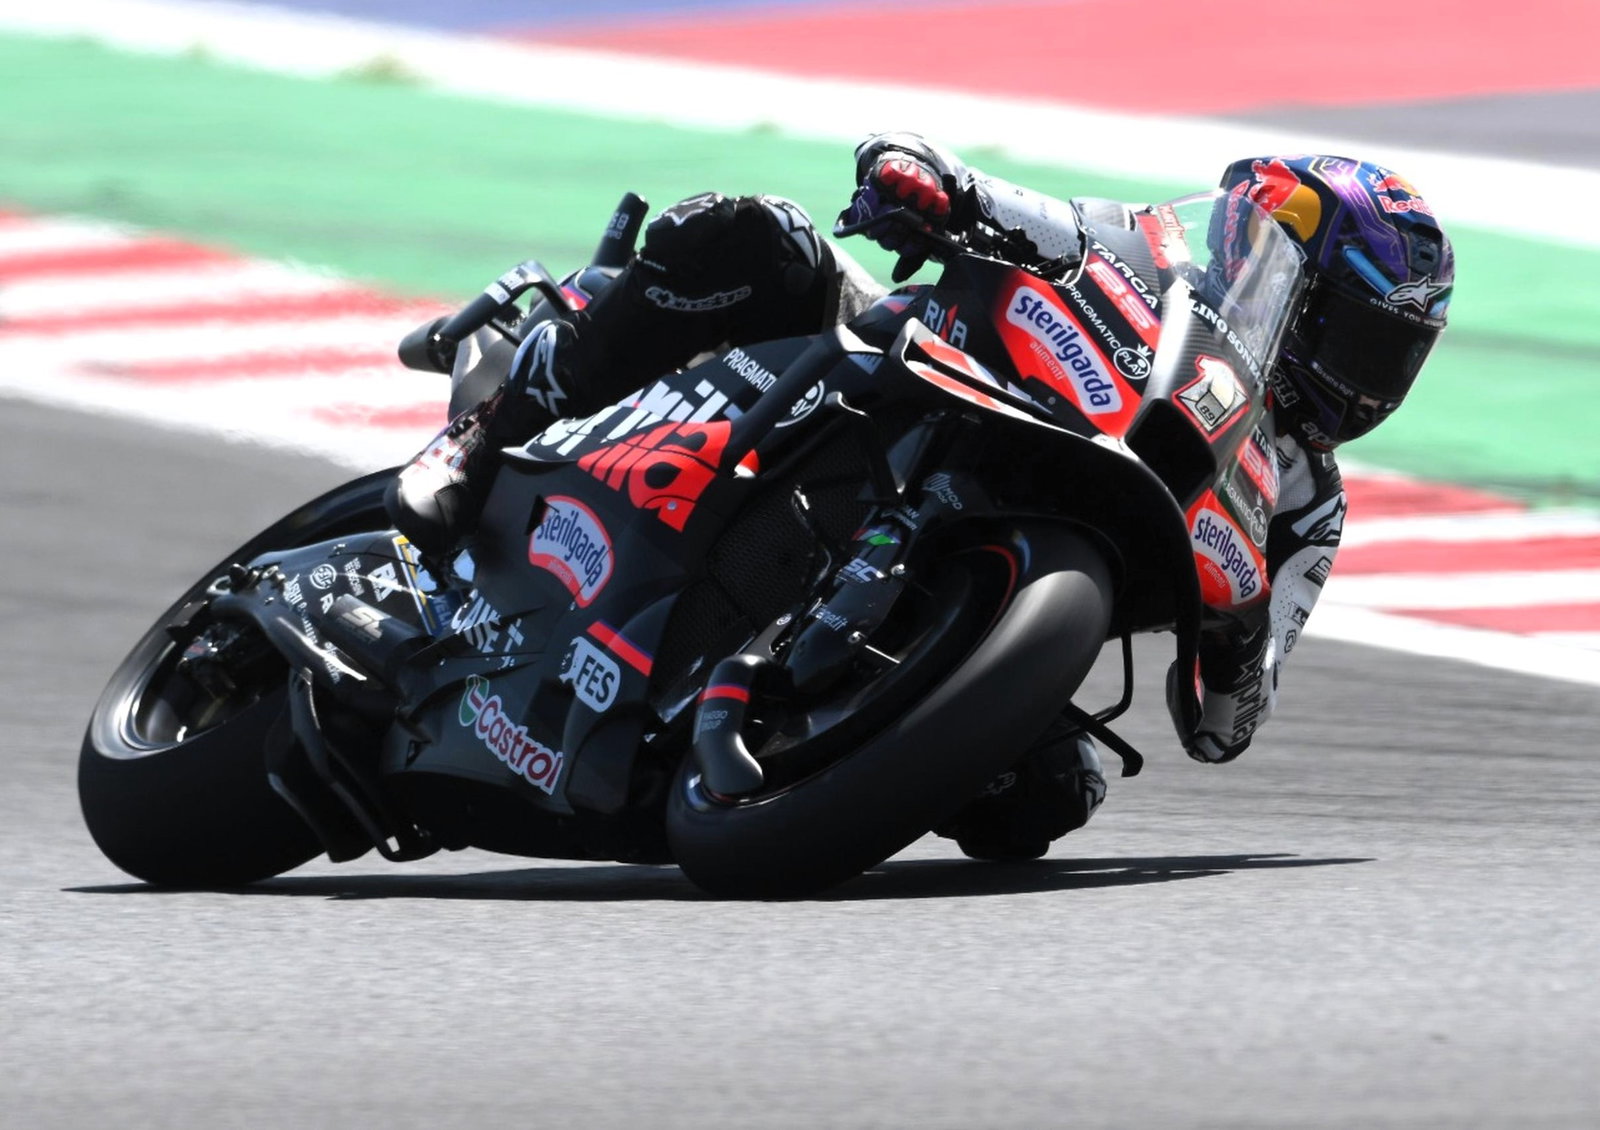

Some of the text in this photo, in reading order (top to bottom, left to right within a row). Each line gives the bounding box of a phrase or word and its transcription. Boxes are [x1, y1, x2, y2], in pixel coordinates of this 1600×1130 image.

[1085, 261, 1151, 329] BS
[1091, 240, 1159, 310] TARGA
[1369, 297, 1400, 315] GIVES
[1403, 311, 1421, 324] YOU
[1014, 294, 1112, 407] sterilgarda
[1029, 340, 1066, 382] alimenti
[1065, 283, 1146, 376] PRAGMATIC PLAY
[1199, 404, 1217, 422] 89
[536, 509, 606, 587] sterilgarda
[1194, 515, 1257, 598] sterilgarda
[477, 699, 563, 789] Castrol
[1231, 664, 1268, 746] aprilia
